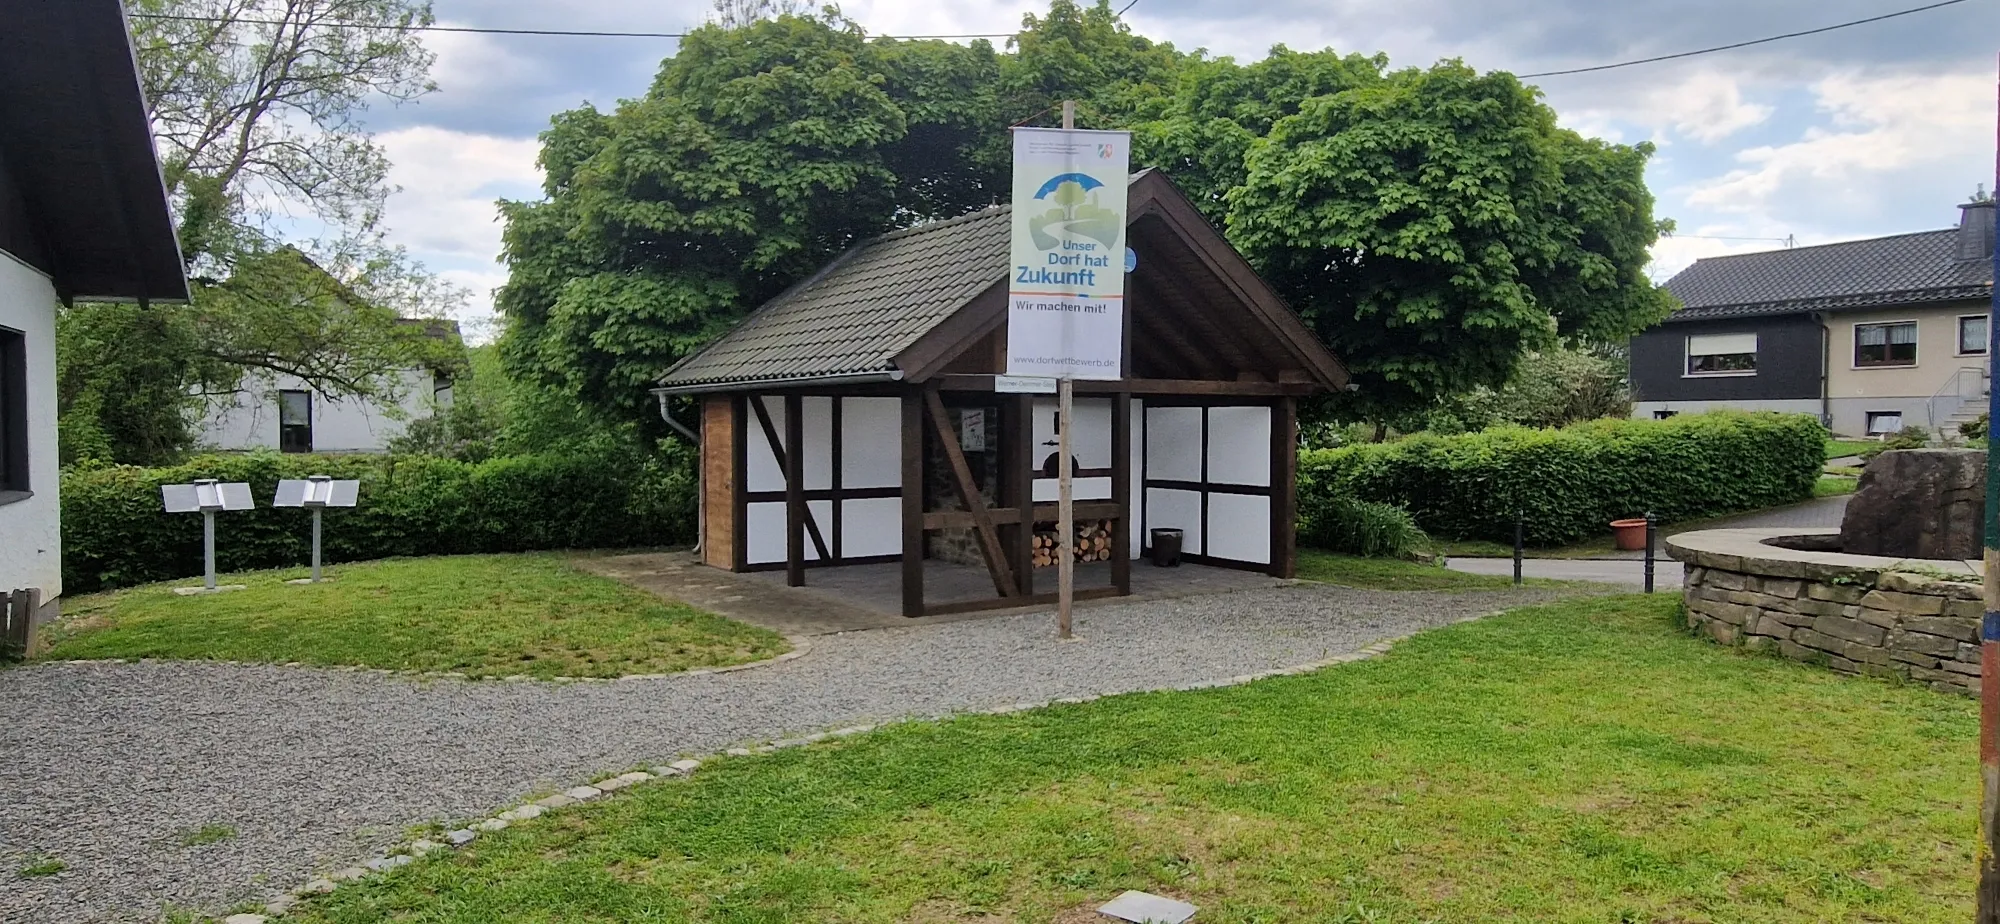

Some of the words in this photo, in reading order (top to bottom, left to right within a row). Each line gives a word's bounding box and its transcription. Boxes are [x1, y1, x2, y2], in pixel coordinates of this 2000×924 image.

[1063, 240, 1097, 251] Unser
[1048, 253, 1081, 266] Dorf
[1084, 254, 1109, 267] hat
[1016, 266, 1096, 286] Zukunft
[1016, 301, 1034, 311] Wir
[1036, 302, 1081, 313] machen
[1084, 304, 1107, 314] mit!
[1014, 356, 1115, 368] www.dorfwettbewerb.de
